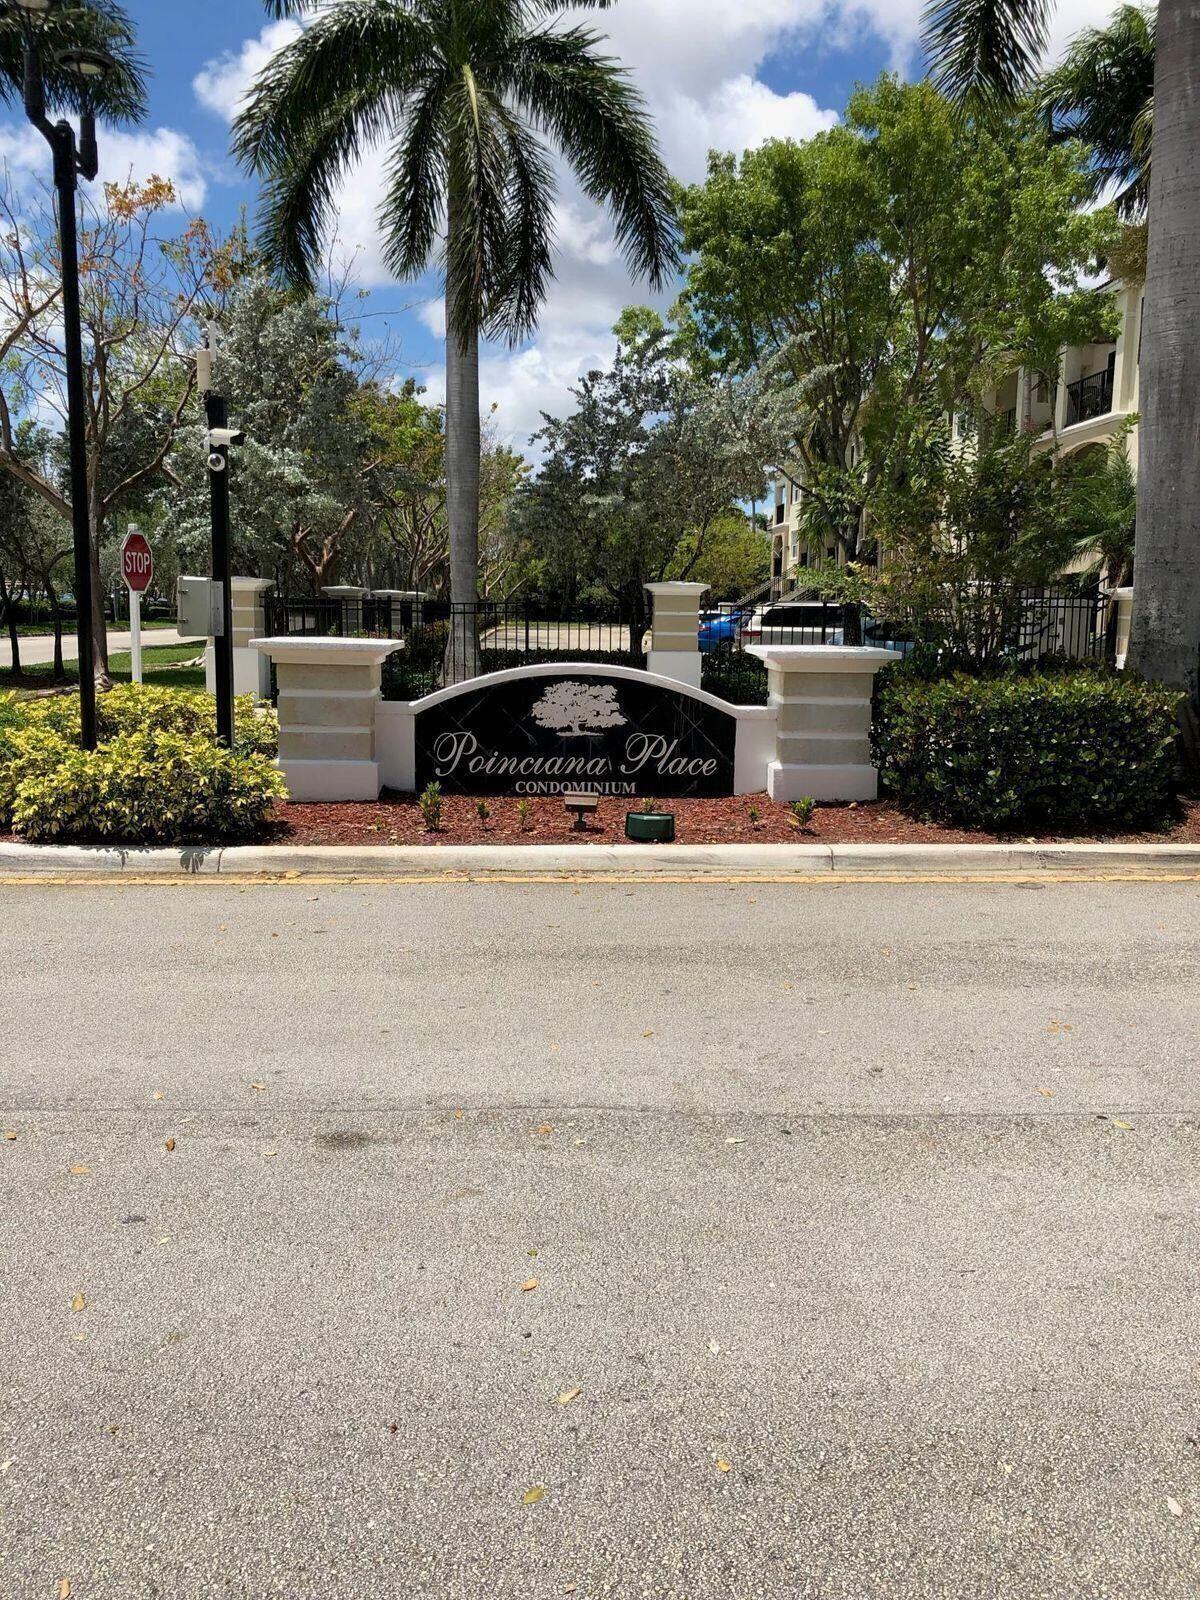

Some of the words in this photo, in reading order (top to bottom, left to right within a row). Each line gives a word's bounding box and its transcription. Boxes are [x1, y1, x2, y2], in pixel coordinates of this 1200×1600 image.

[125, 551, 150, 574] STOP
[433, 730, 608, 777] Poinciana
[620, 732, 718, 776] Place
[515, 780, 637, 795] CONDOMINIUM
